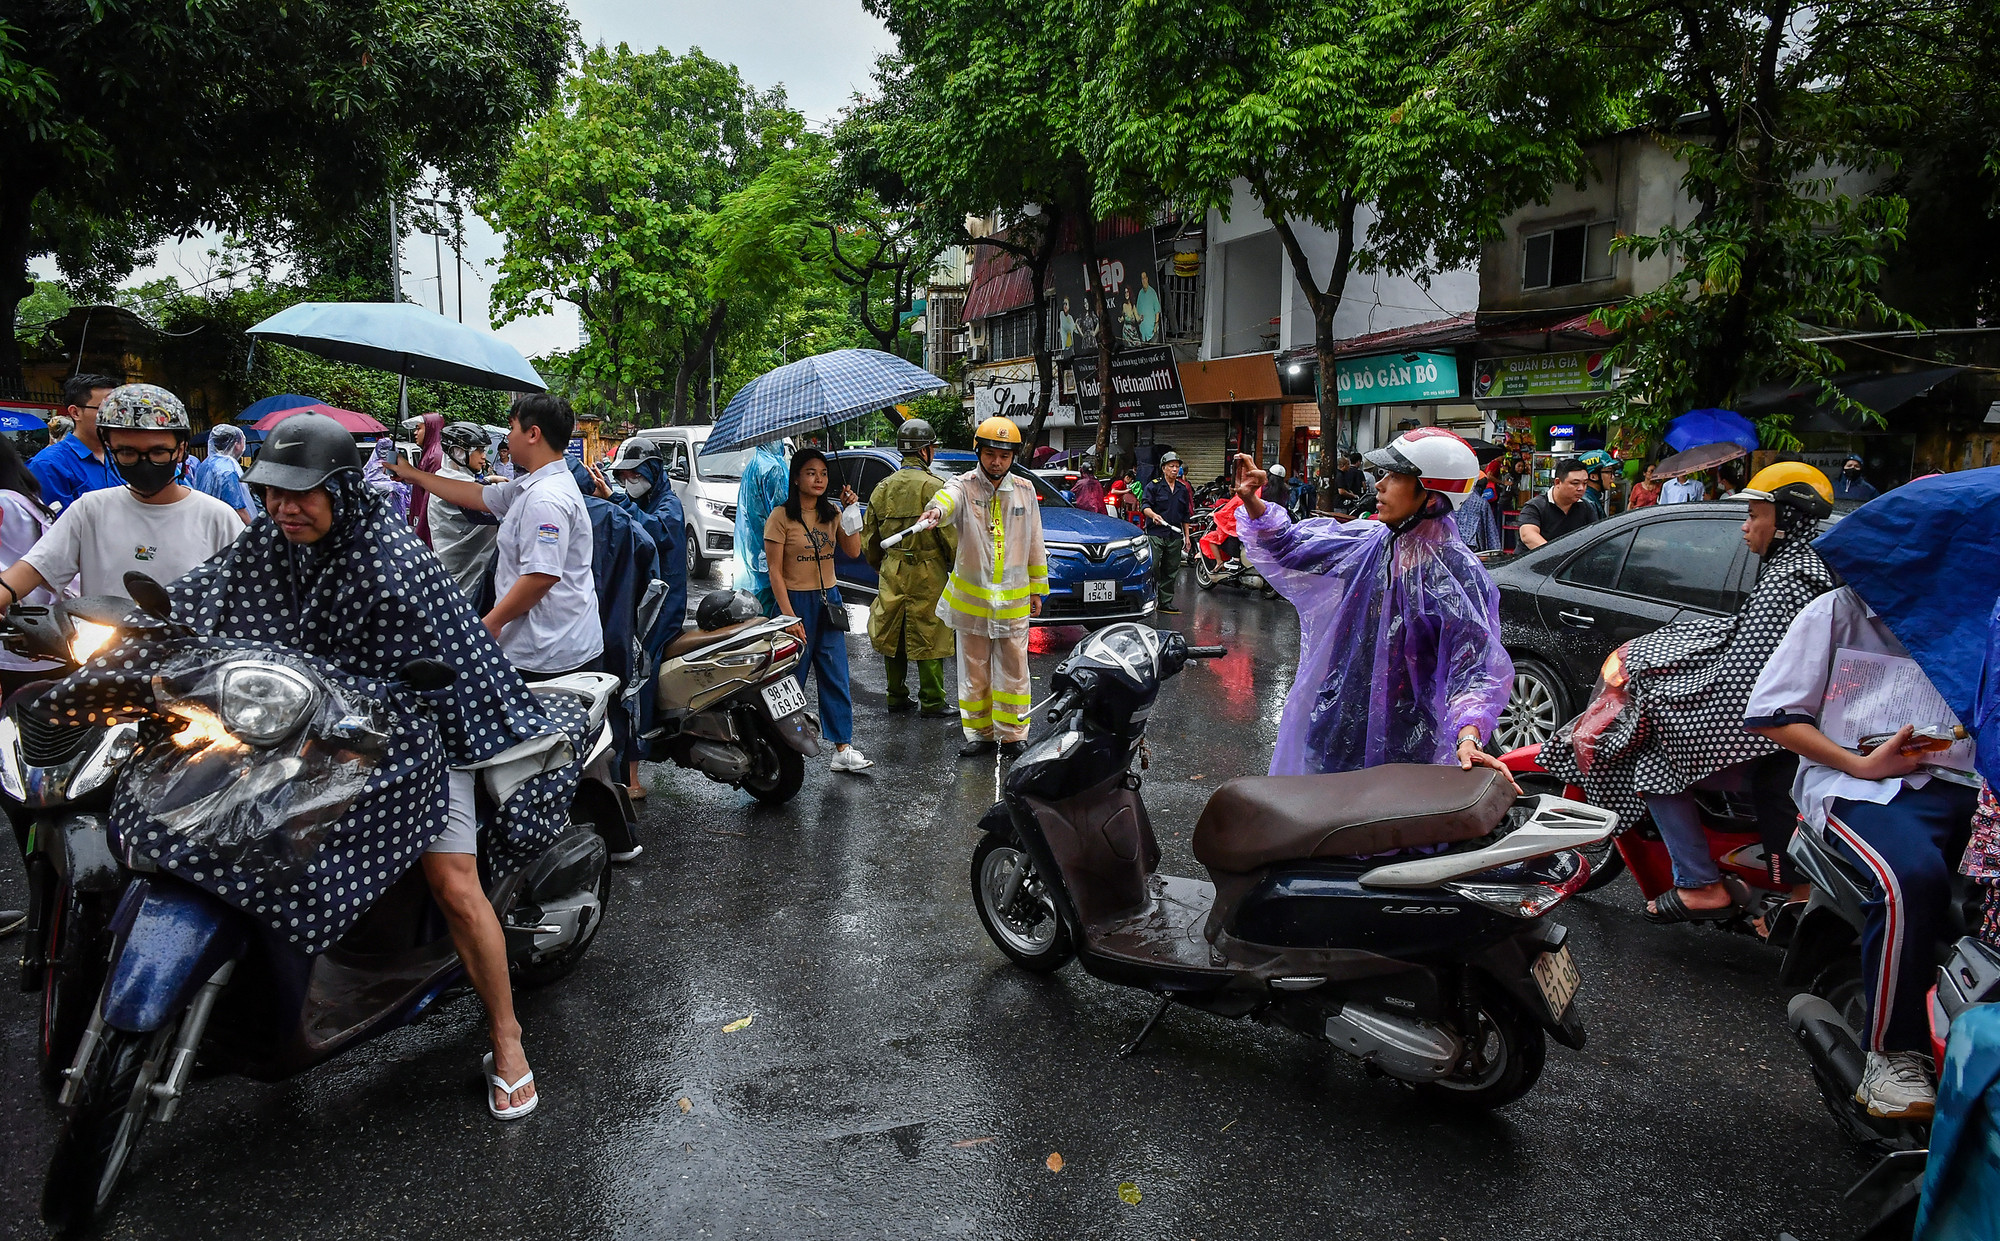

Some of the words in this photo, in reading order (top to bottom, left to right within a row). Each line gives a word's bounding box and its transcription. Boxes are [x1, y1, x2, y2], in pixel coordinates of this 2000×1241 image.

[1509, 359, 1538, 372] QUÁN
[1541, 356, 1555, 370] BÀ
[1558, 354, 1578, 368] GIÀ
[1112, 369, 1173, 394] Vietnam1111
[1353, 365, 1374, 390] BÒ
[1377, 363, 1411, 388] GÂN
[1414, 358, 1438, 384] BÒ
[1557, 426, 1574, 435] pepsi
[1088, 592, 1113, 602] 154.18
[1093, 582, 1107, 591] 30K
[767, 678, 796, 702] 98-M1
[771, 691, 806, 716] 169.48
[1381, 905, 1461, 915] LEAD
[1547, 960, 1578, 1017] 621.98
